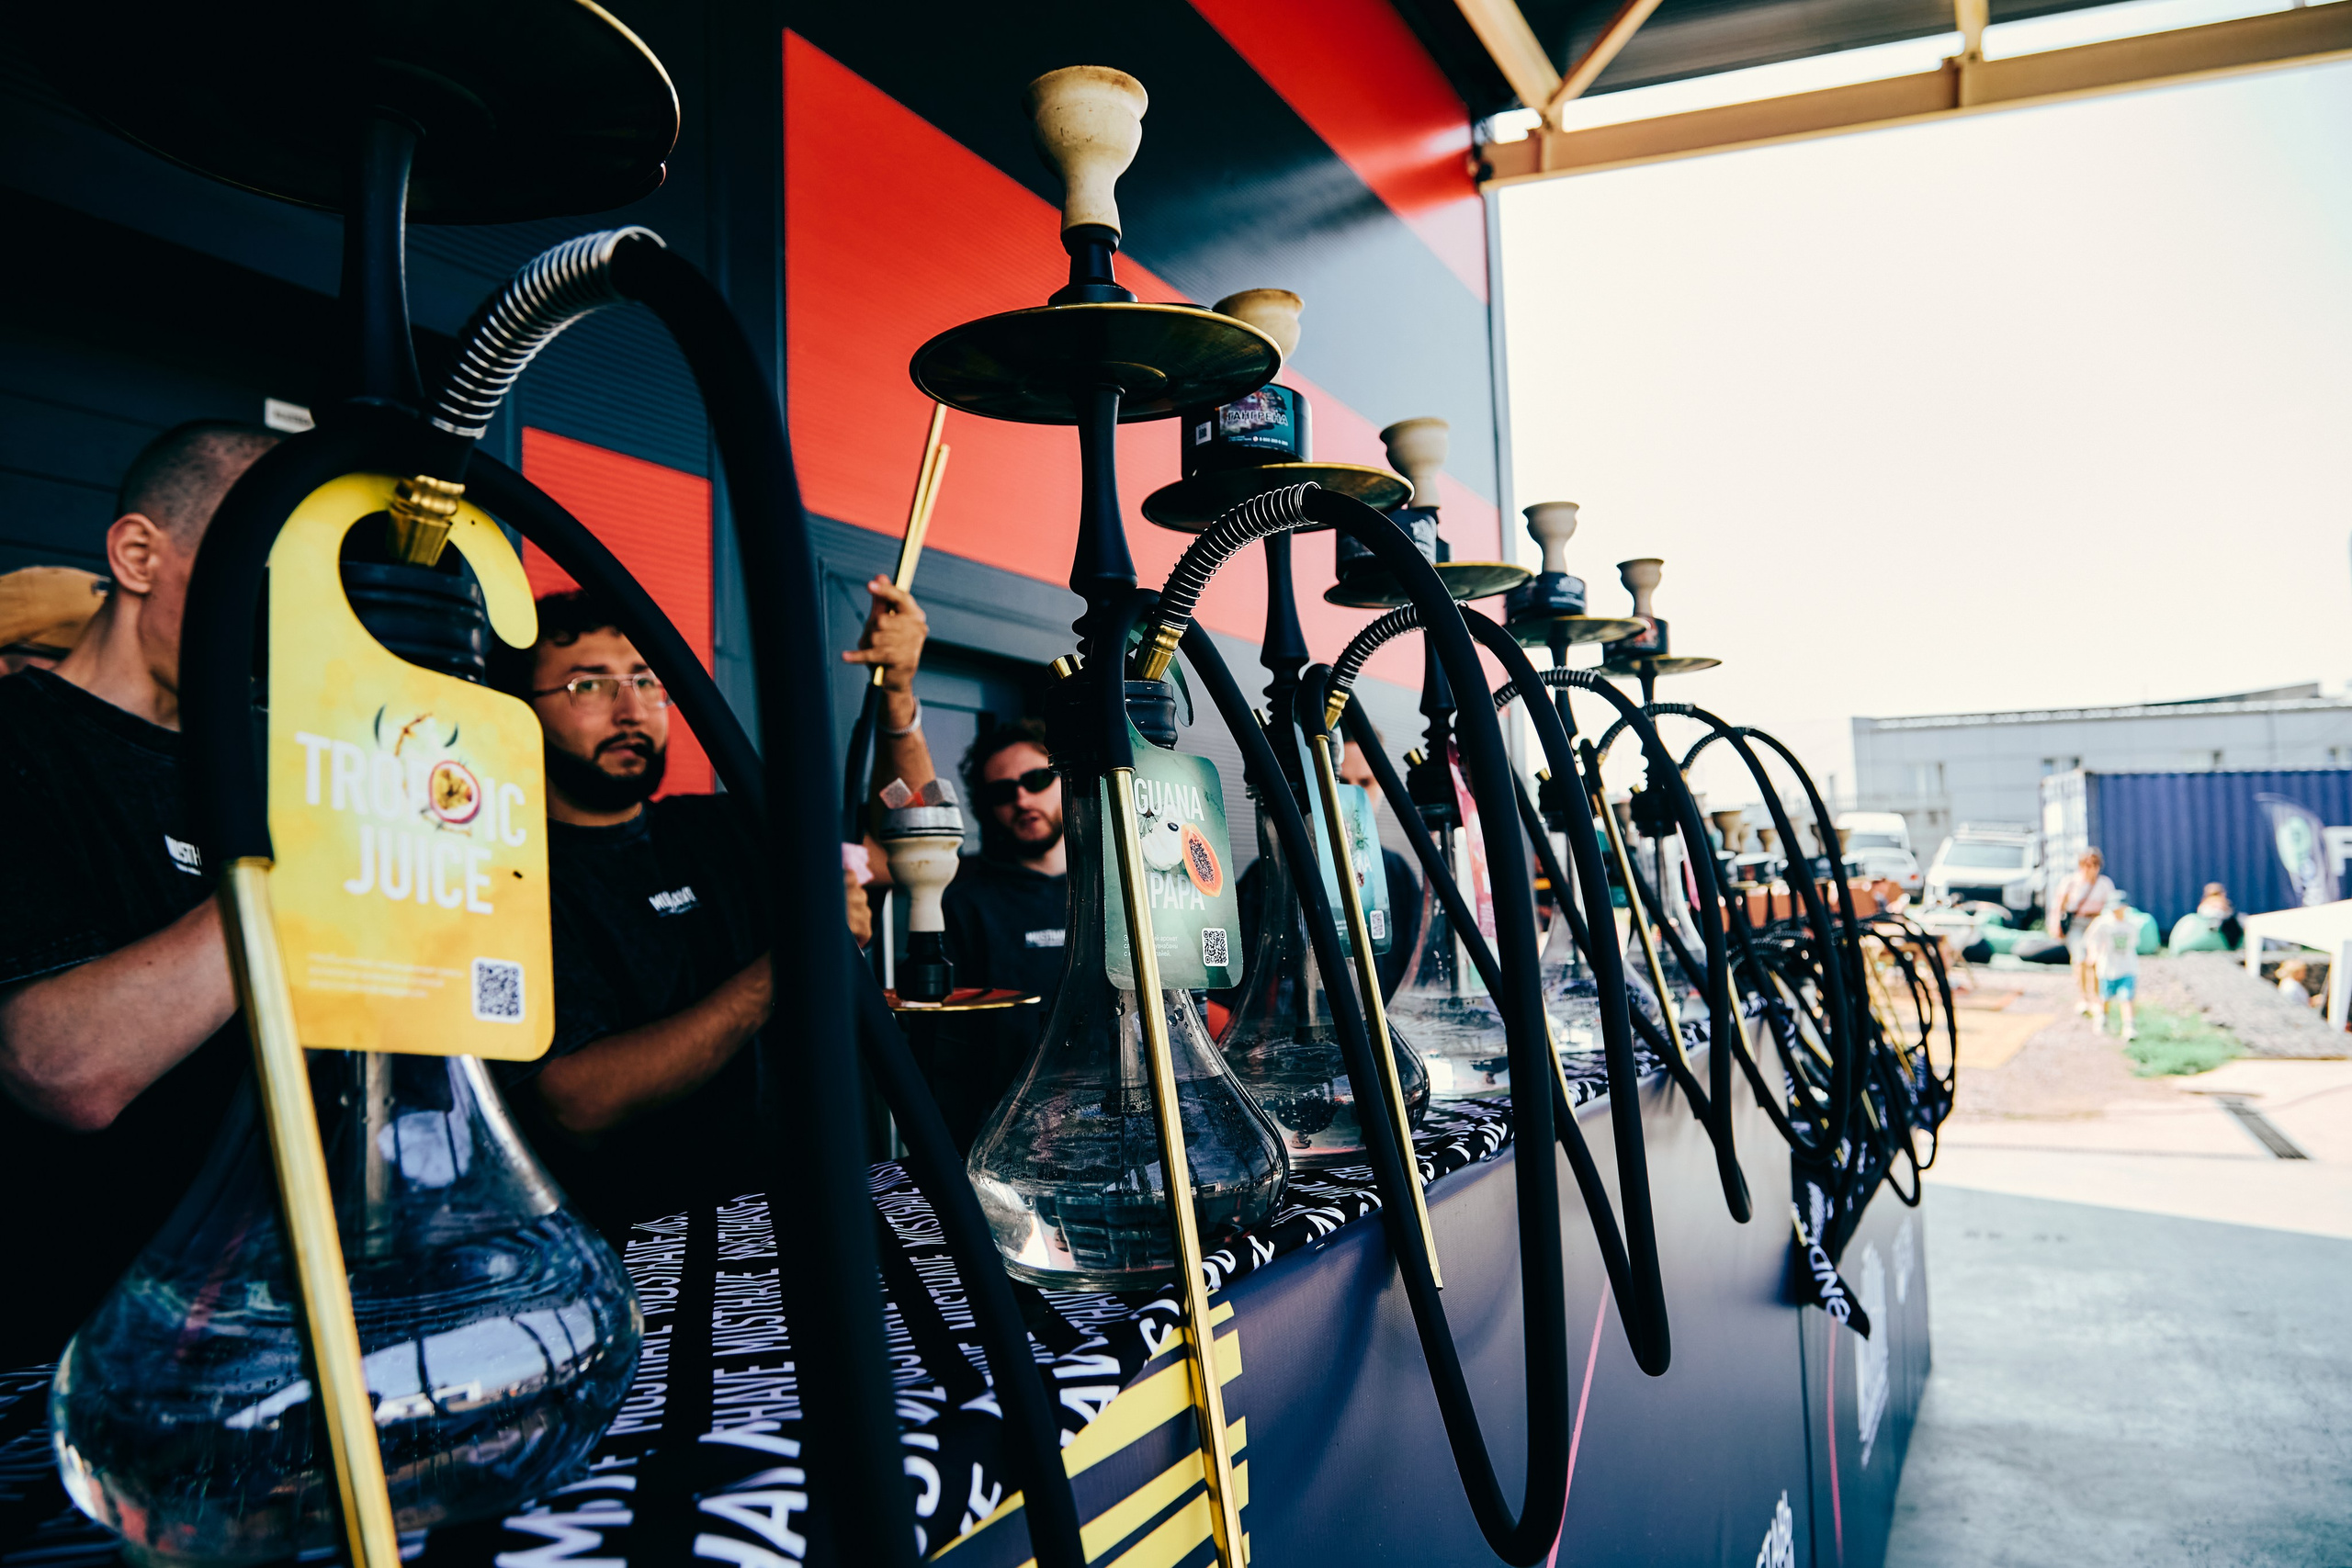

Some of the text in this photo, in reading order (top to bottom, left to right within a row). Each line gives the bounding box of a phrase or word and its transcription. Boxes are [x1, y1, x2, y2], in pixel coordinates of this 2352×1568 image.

[1227, 410, 1288, 426] ГАНГРЕНА
[1134, 778, 1204, 821] GUANA
[343, 823, 493, 915] JUICE
[1150, 873, 1205, 910] PAPA
[711, 1269, 791, 1356] MUSTHAVE
